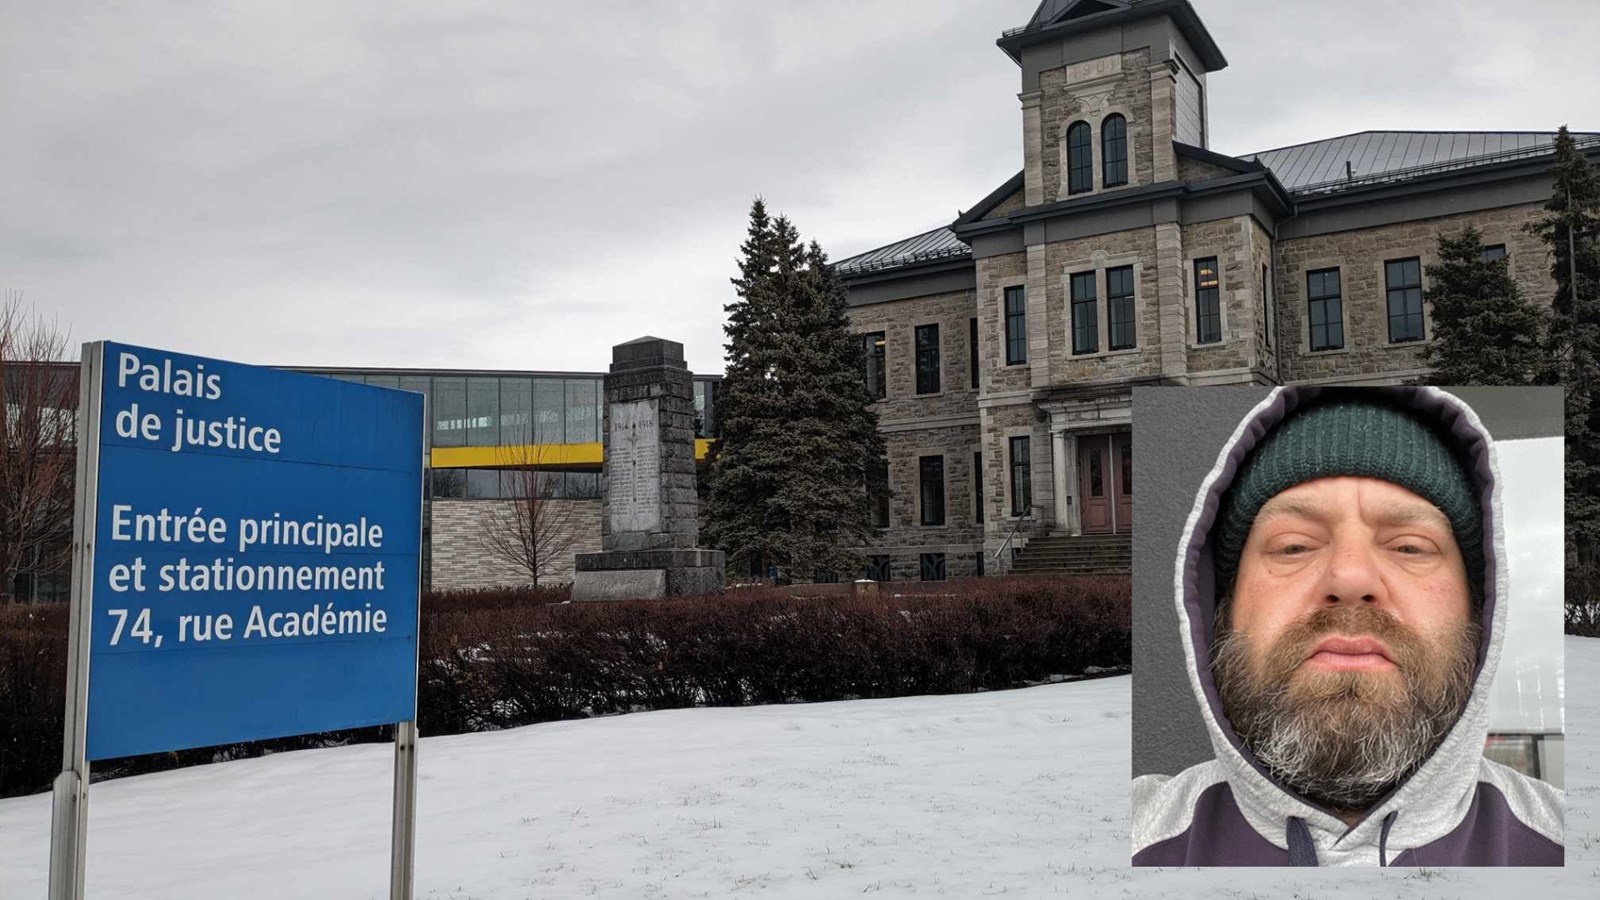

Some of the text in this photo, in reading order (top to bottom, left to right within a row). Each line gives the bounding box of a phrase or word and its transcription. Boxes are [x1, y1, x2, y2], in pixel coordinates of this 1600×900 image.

[118, 352, 221, 400] Palais
[115, 403, 281, 453] de justice
[111, 504, 383, 554] Entrée principale
[108, 557, 385, 592] et stationnement
[107, 603, 387, 648] 74, rue Académie
